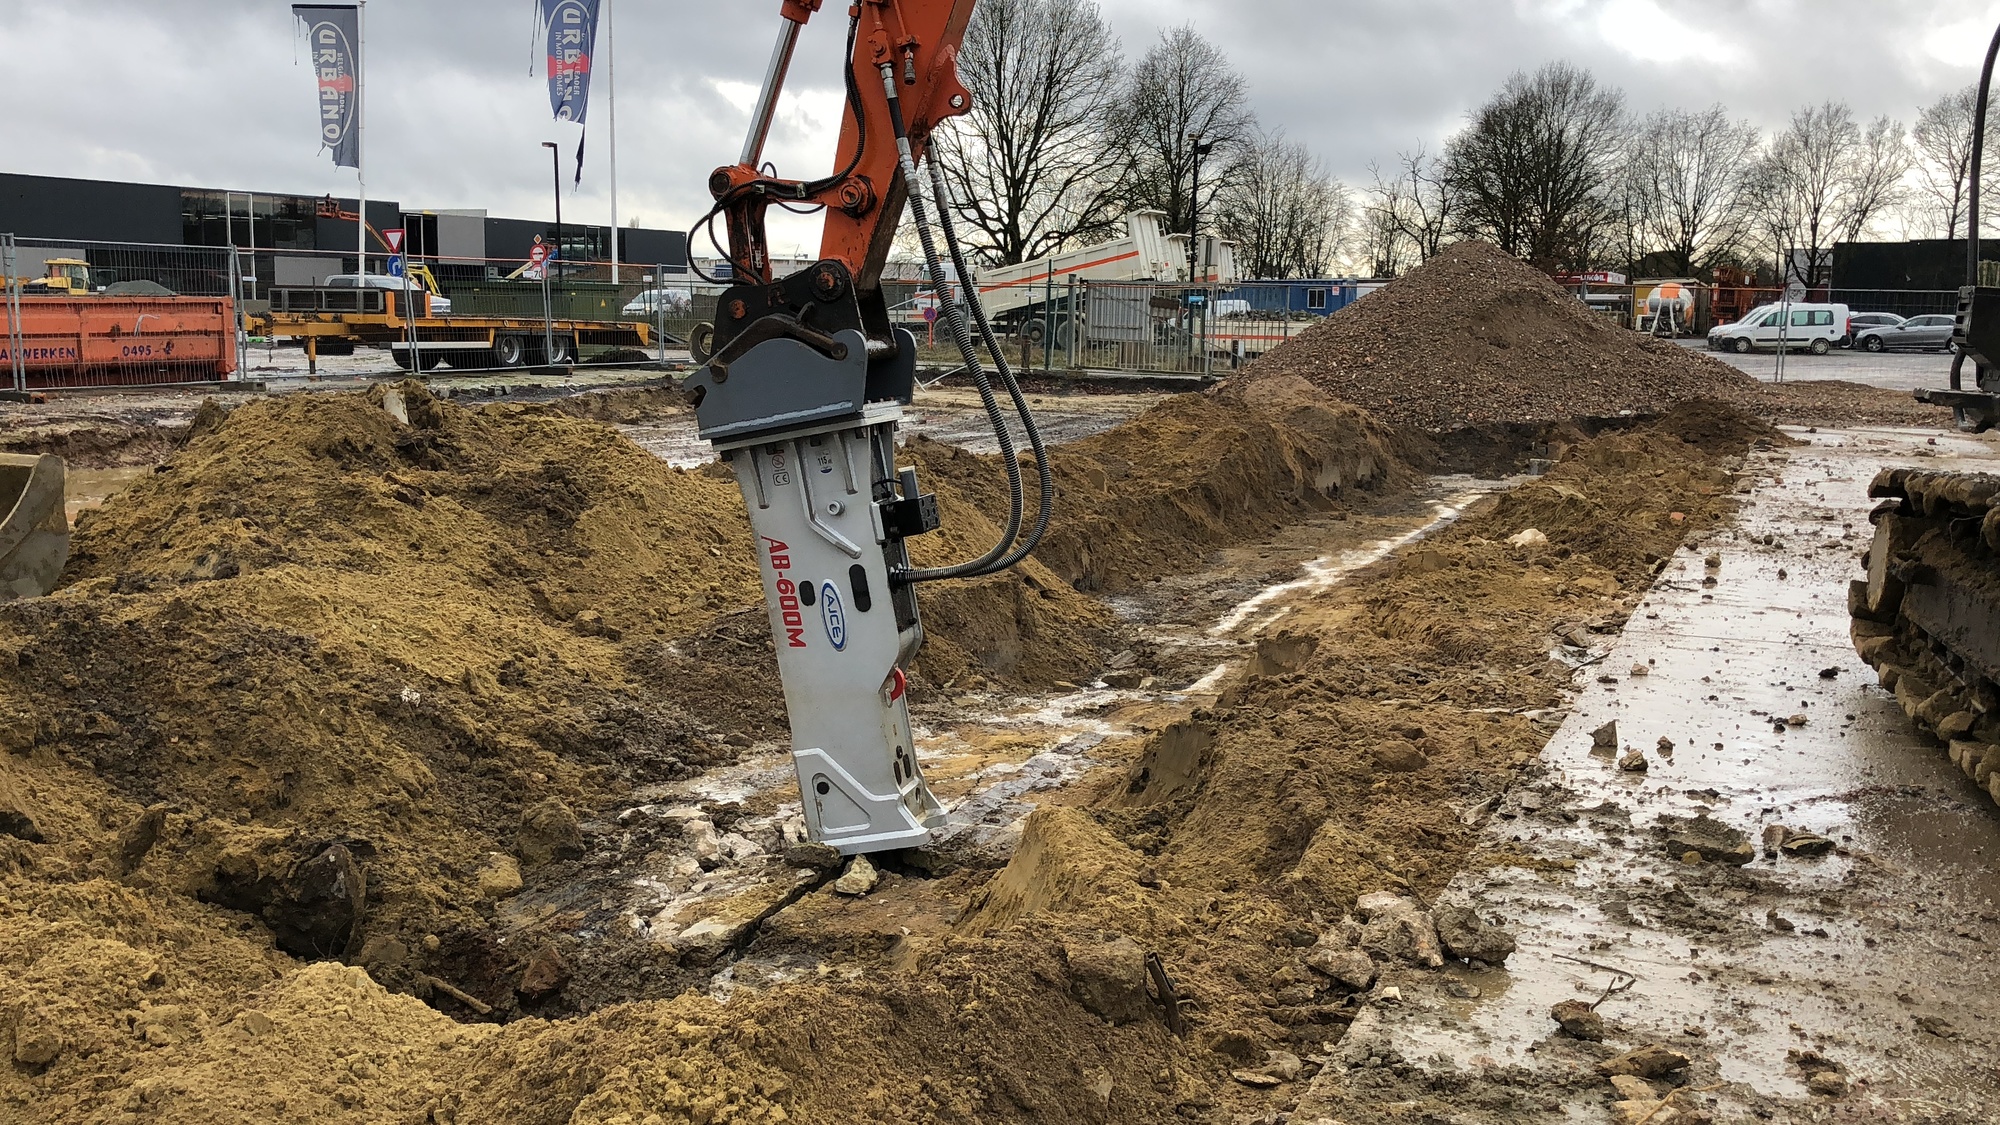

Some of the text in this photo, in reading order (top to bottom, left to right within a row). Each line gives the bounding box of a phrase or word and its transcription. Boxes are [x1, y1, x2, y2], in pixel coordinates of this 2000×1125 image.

[556, 31, 562, 41] IN
[318, 29, 341, 140] URBANO
[573, 65, 581, 95] LEADER
[761, 535, 807, 648] AB-600M
[825, 594, 841, 639] AJCE
